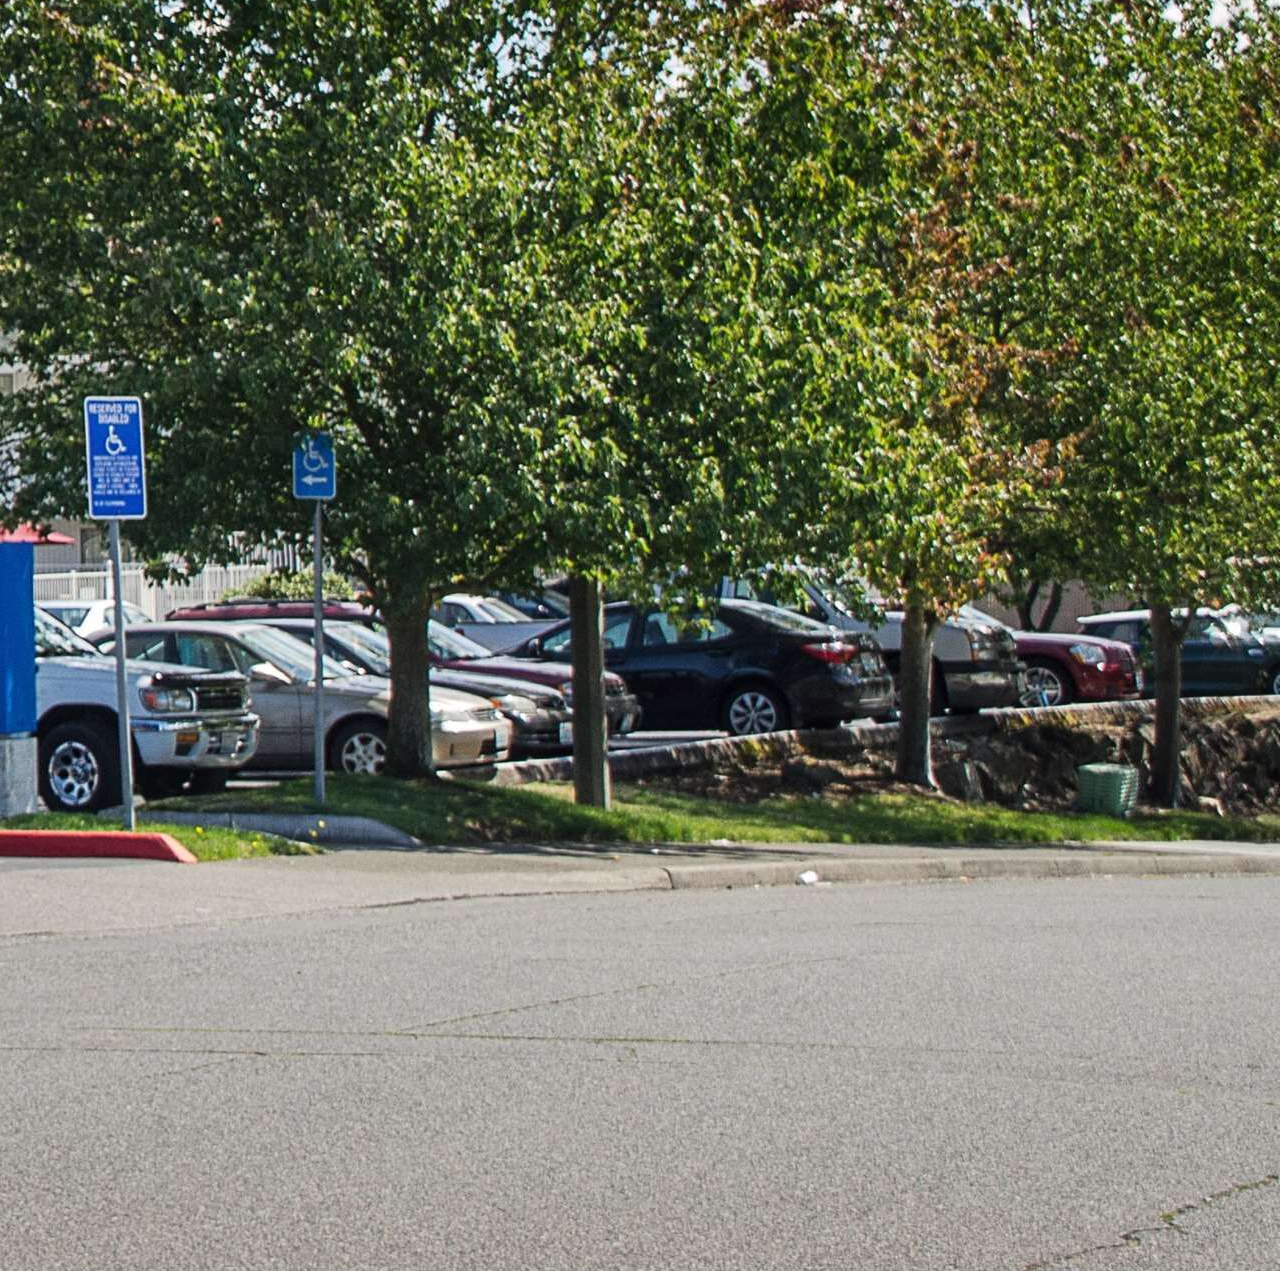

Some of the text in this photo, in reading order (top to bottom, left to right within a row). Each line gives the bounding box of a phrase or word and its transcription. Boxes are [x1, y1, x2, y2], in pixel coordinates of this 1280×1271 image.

[89, 403, 137, 414] RESERVED FOR
[97, 413, 129, 424] DISABLED
